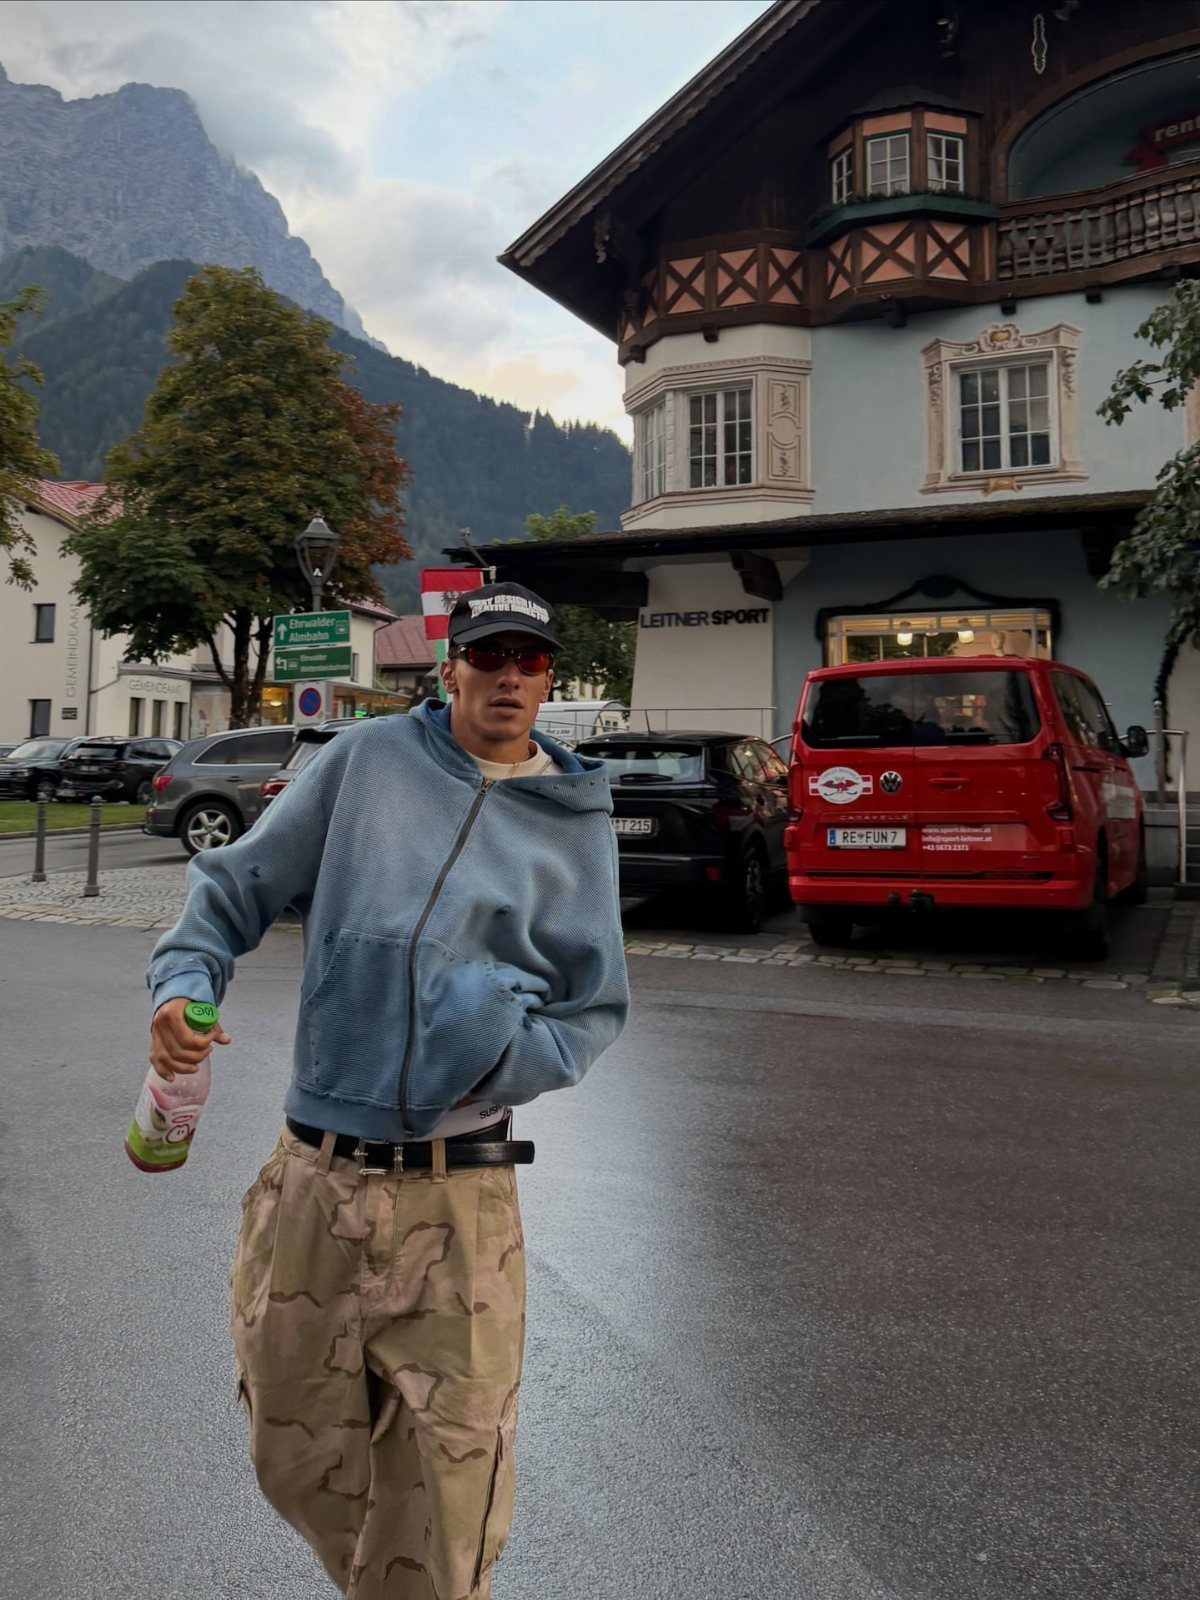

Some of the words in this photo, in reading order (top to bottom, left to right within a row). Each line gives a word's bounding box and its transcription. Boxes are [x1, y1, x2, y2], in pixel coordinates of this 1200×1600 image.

[289, 617, 336, 629] Ehrwalder
[640, 611, 709, 628] LEITNER
[711, 608, 769, 625] SPORT
[289, 631, 329, 642] Almbahn
[629, 820, 650, 831] 215
[842, 831, 857, 844] RE
[865, 831, 888, 844] FUN
[890, 831, 898, 843] 7
